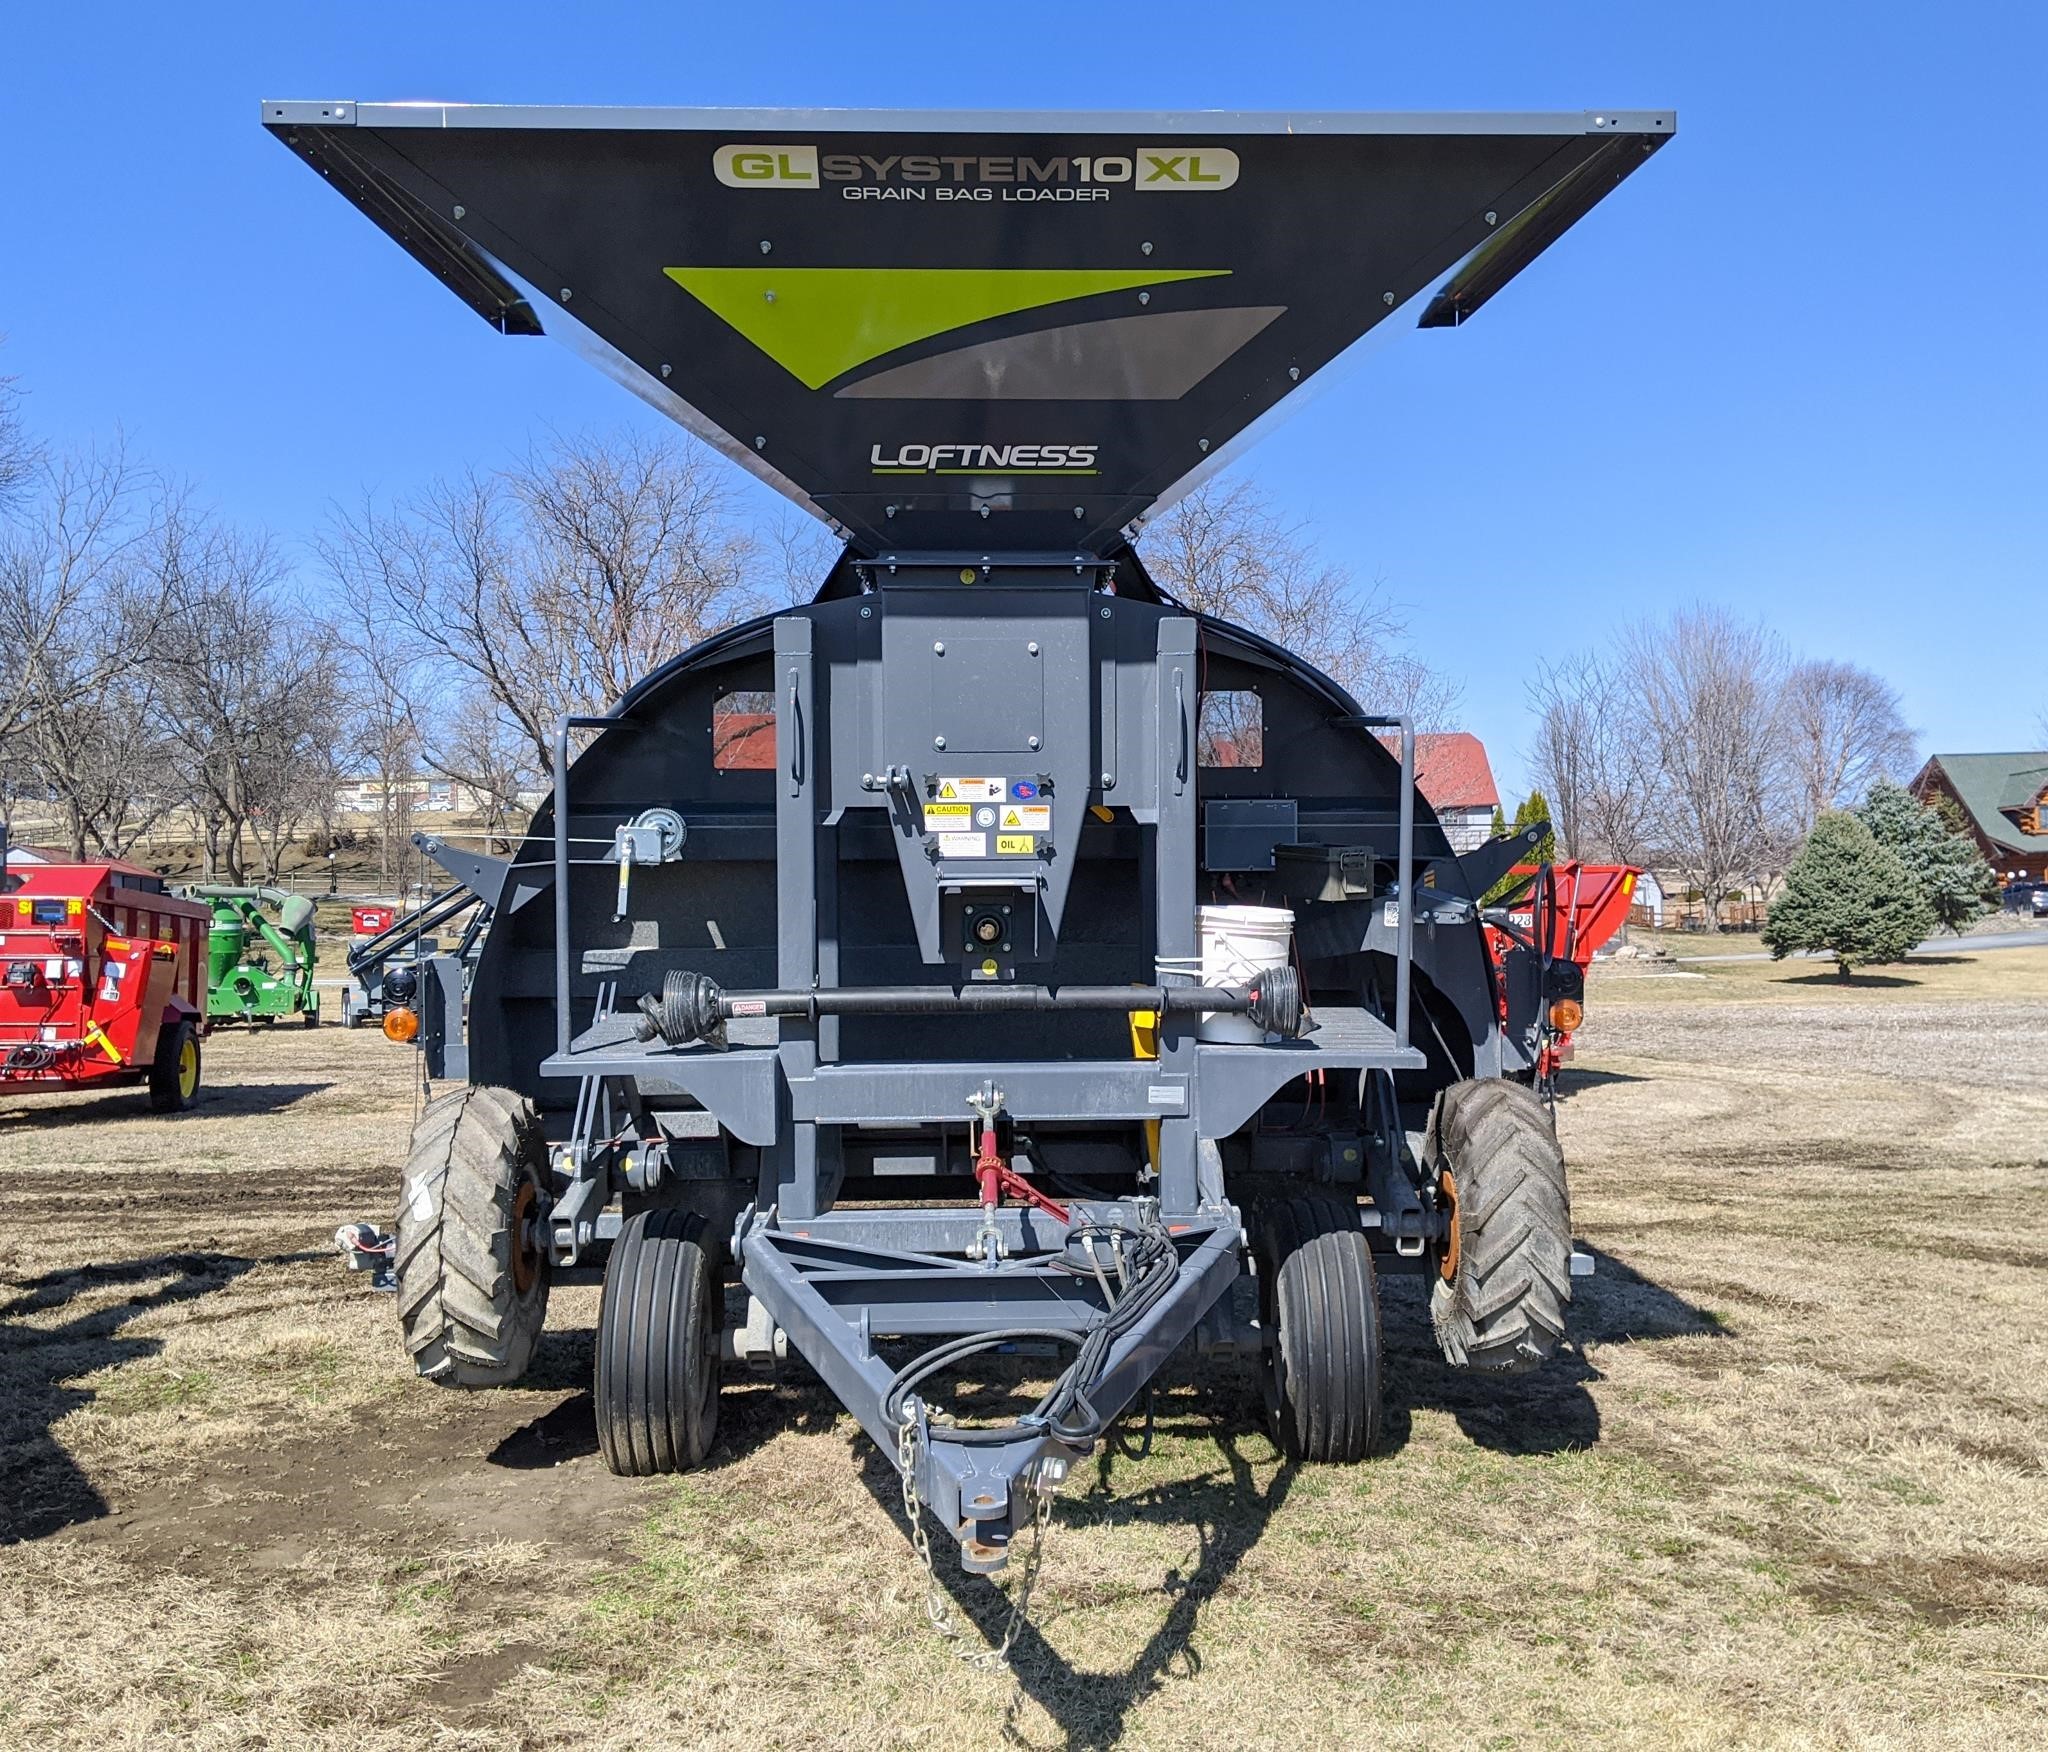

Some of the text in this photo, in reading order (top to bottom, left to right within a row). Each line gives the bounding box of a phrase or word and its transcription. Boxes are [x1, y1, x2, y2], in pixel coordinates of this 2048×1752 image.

[731, 153, 812, 180] GL
[1144, 156, 1221, 182] XL
[842, 187, 1110, 202] GRAIN BAG LOADER
[870, 444, 1099, 469] LOFTNESS
[1001, 840, 1015, 849] OIL
[741, 1003, 764, 1011] DANGER
